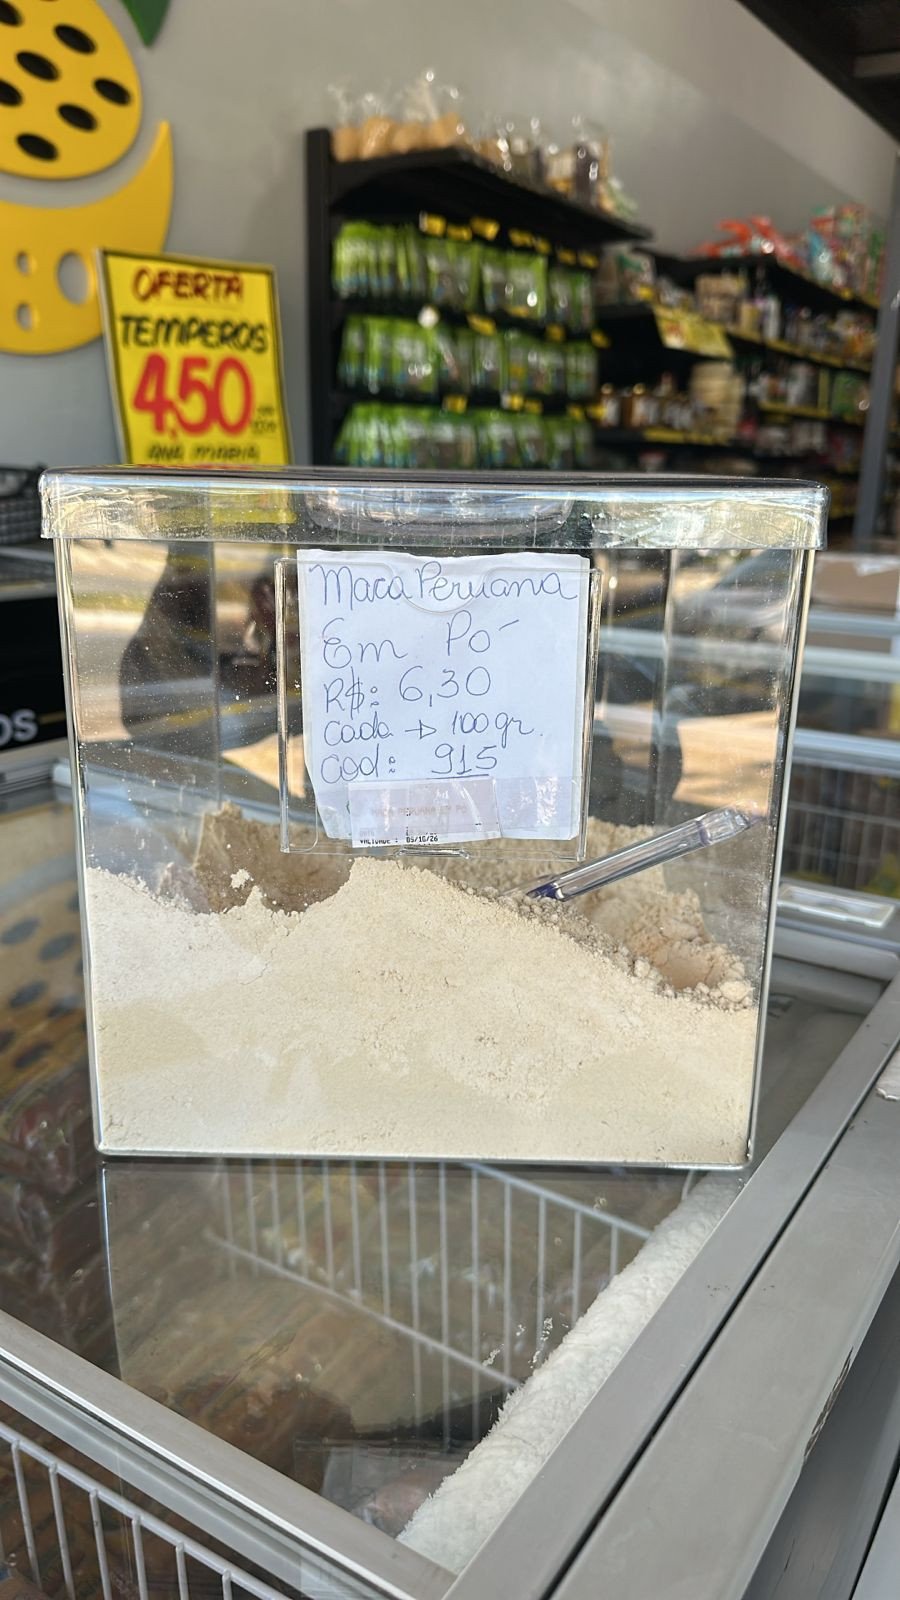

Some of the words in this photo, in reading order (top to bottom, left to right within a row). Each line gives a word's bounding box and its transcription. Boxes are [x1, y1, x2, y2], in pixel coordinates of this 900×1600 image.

[132, 265, 243, 302] OFERTA
[120, 313, 268, 354] TEMPEROS
[133, 351, 254, 440] 4,50
[416, 560, 578, 602] Peruana
[322, 617, 408, 669] Em
[399, 665, 492, 707] 6,30
[431, 743, 498, 775] 915
